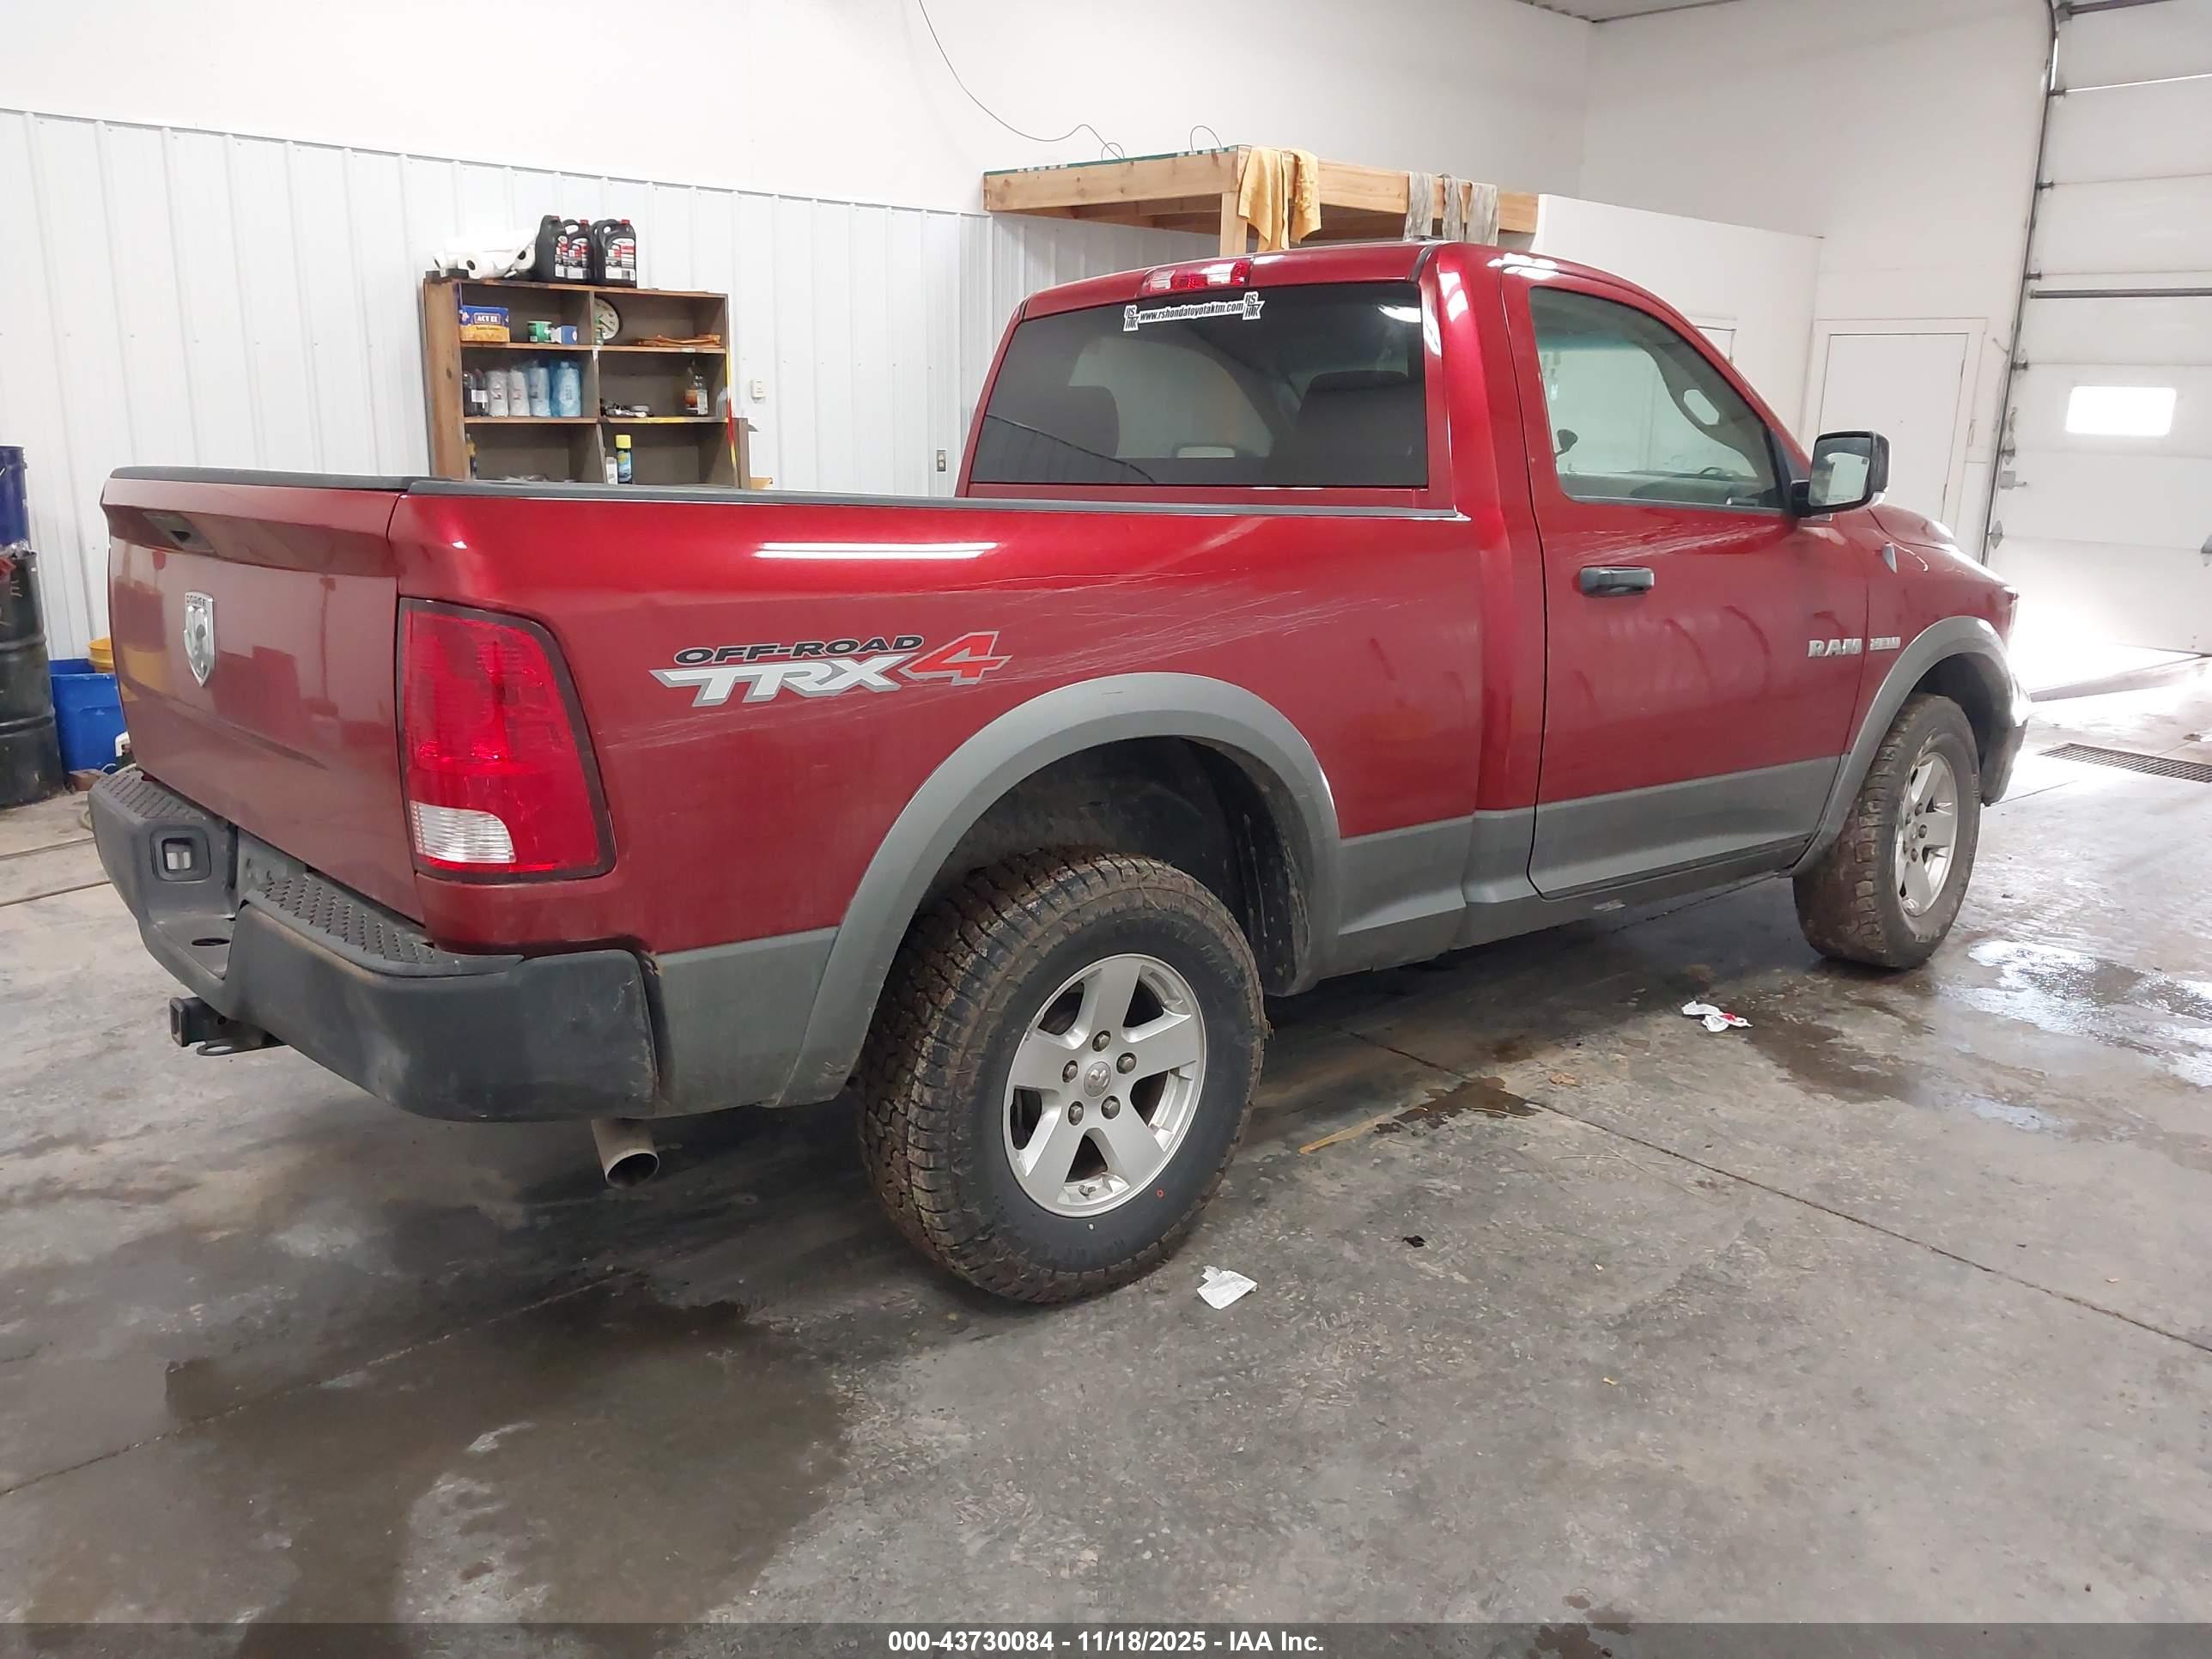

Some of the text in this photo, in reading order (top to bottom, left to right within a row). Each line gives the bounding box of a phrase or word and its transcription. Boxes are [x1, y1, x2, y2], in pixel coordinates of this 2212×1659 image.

[1139, 301, 1244, 321] www.rshondatoyotaktm.com
[674, 635, 925, 665] OFF-ROAD
[1808, 637, 1863, 658] RAM
